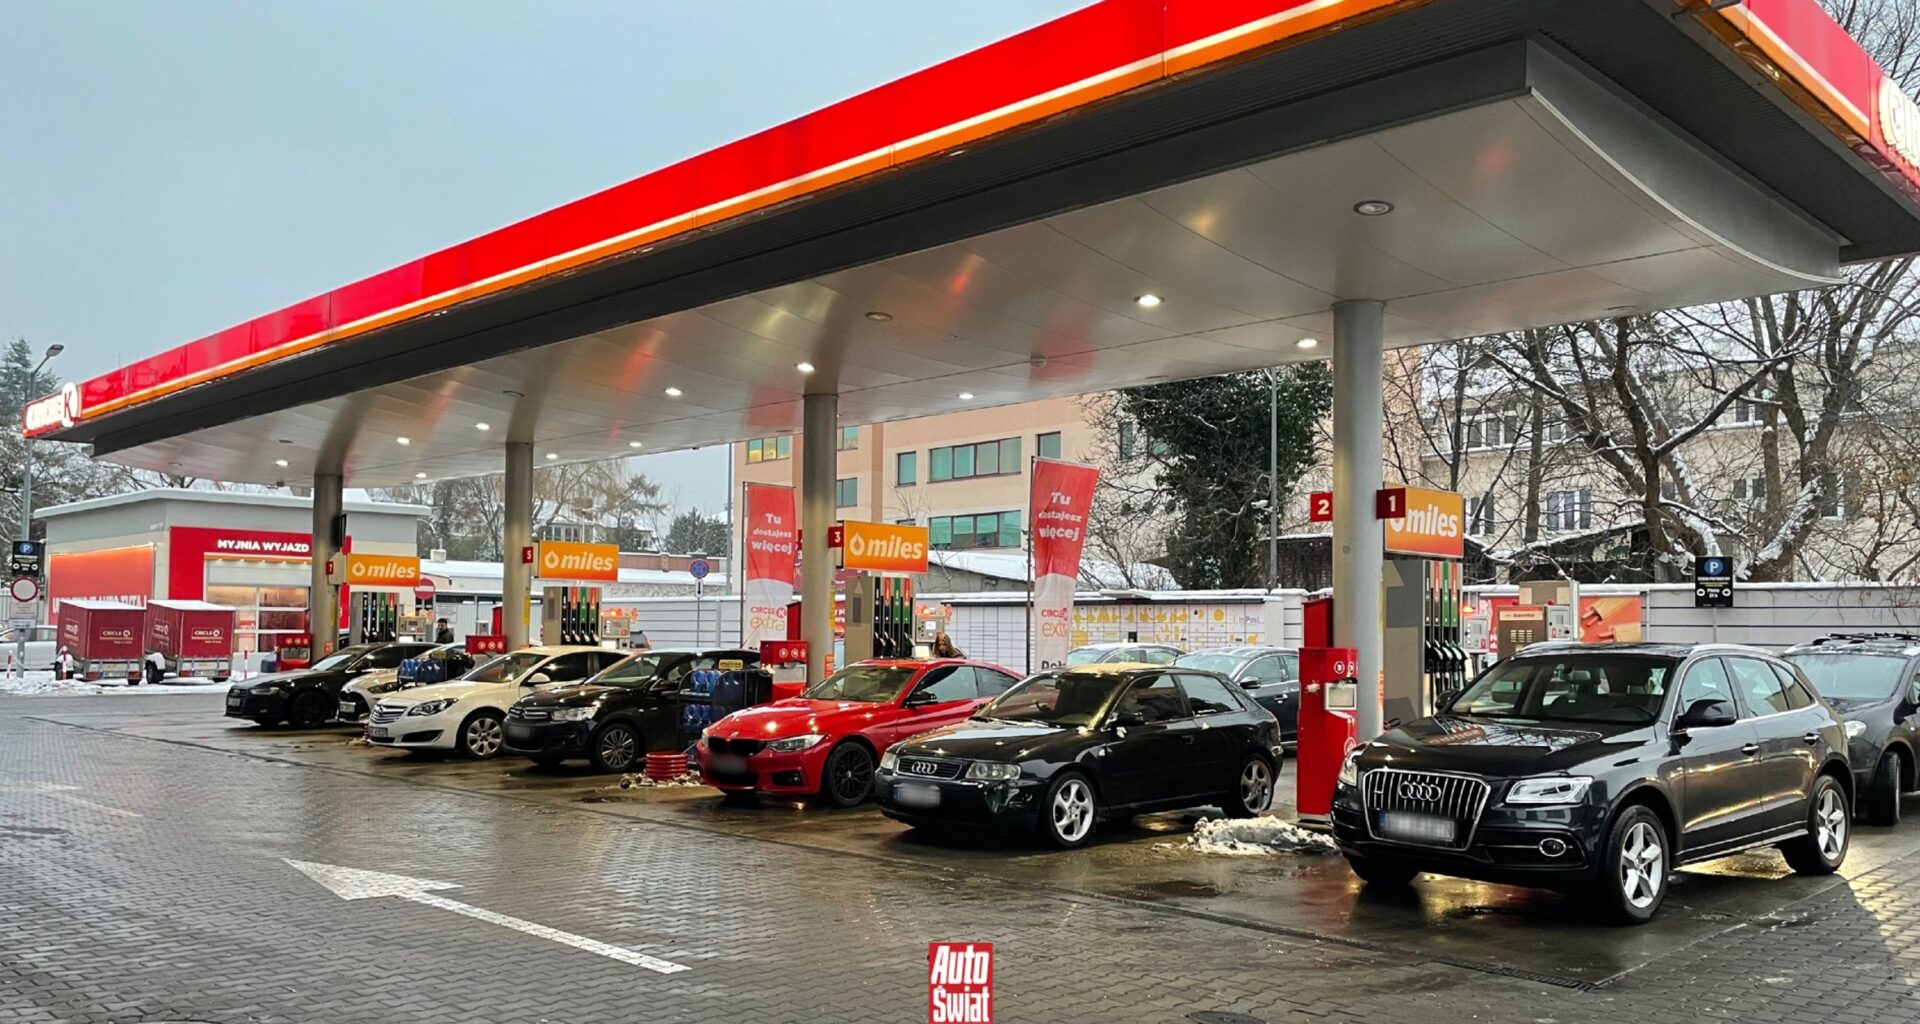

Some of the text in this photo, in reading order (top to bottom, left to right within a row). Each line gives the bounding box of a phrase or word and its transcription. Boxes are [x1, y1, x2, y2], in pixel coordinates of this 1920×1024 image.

[1051, 491, 1071, 505] Tu
[1388, 495, 1396, 512] 1
[1317, 499, 1330, 515] 2
[765, 512, 781, 525] Tu
[1406, 503, 1459, 538] miles
[752, 528, 792, 538] dostajesz
[834, 531, 841, 543] 3
[1038, 524, 1080, 542] więcej
[217, 539, 310, 553] MYJNIA WYJAZD
[751, 540, 793, 555] więcej
[866, 534, 924, 560] miles
[560, 552, 614, 571] miles
[1710, 561, 1719, 573] P
[366, 562, 416, 579] miles
[750, 606, 776, 615] CIRCLE
[750, 616, 786, 631] extra
